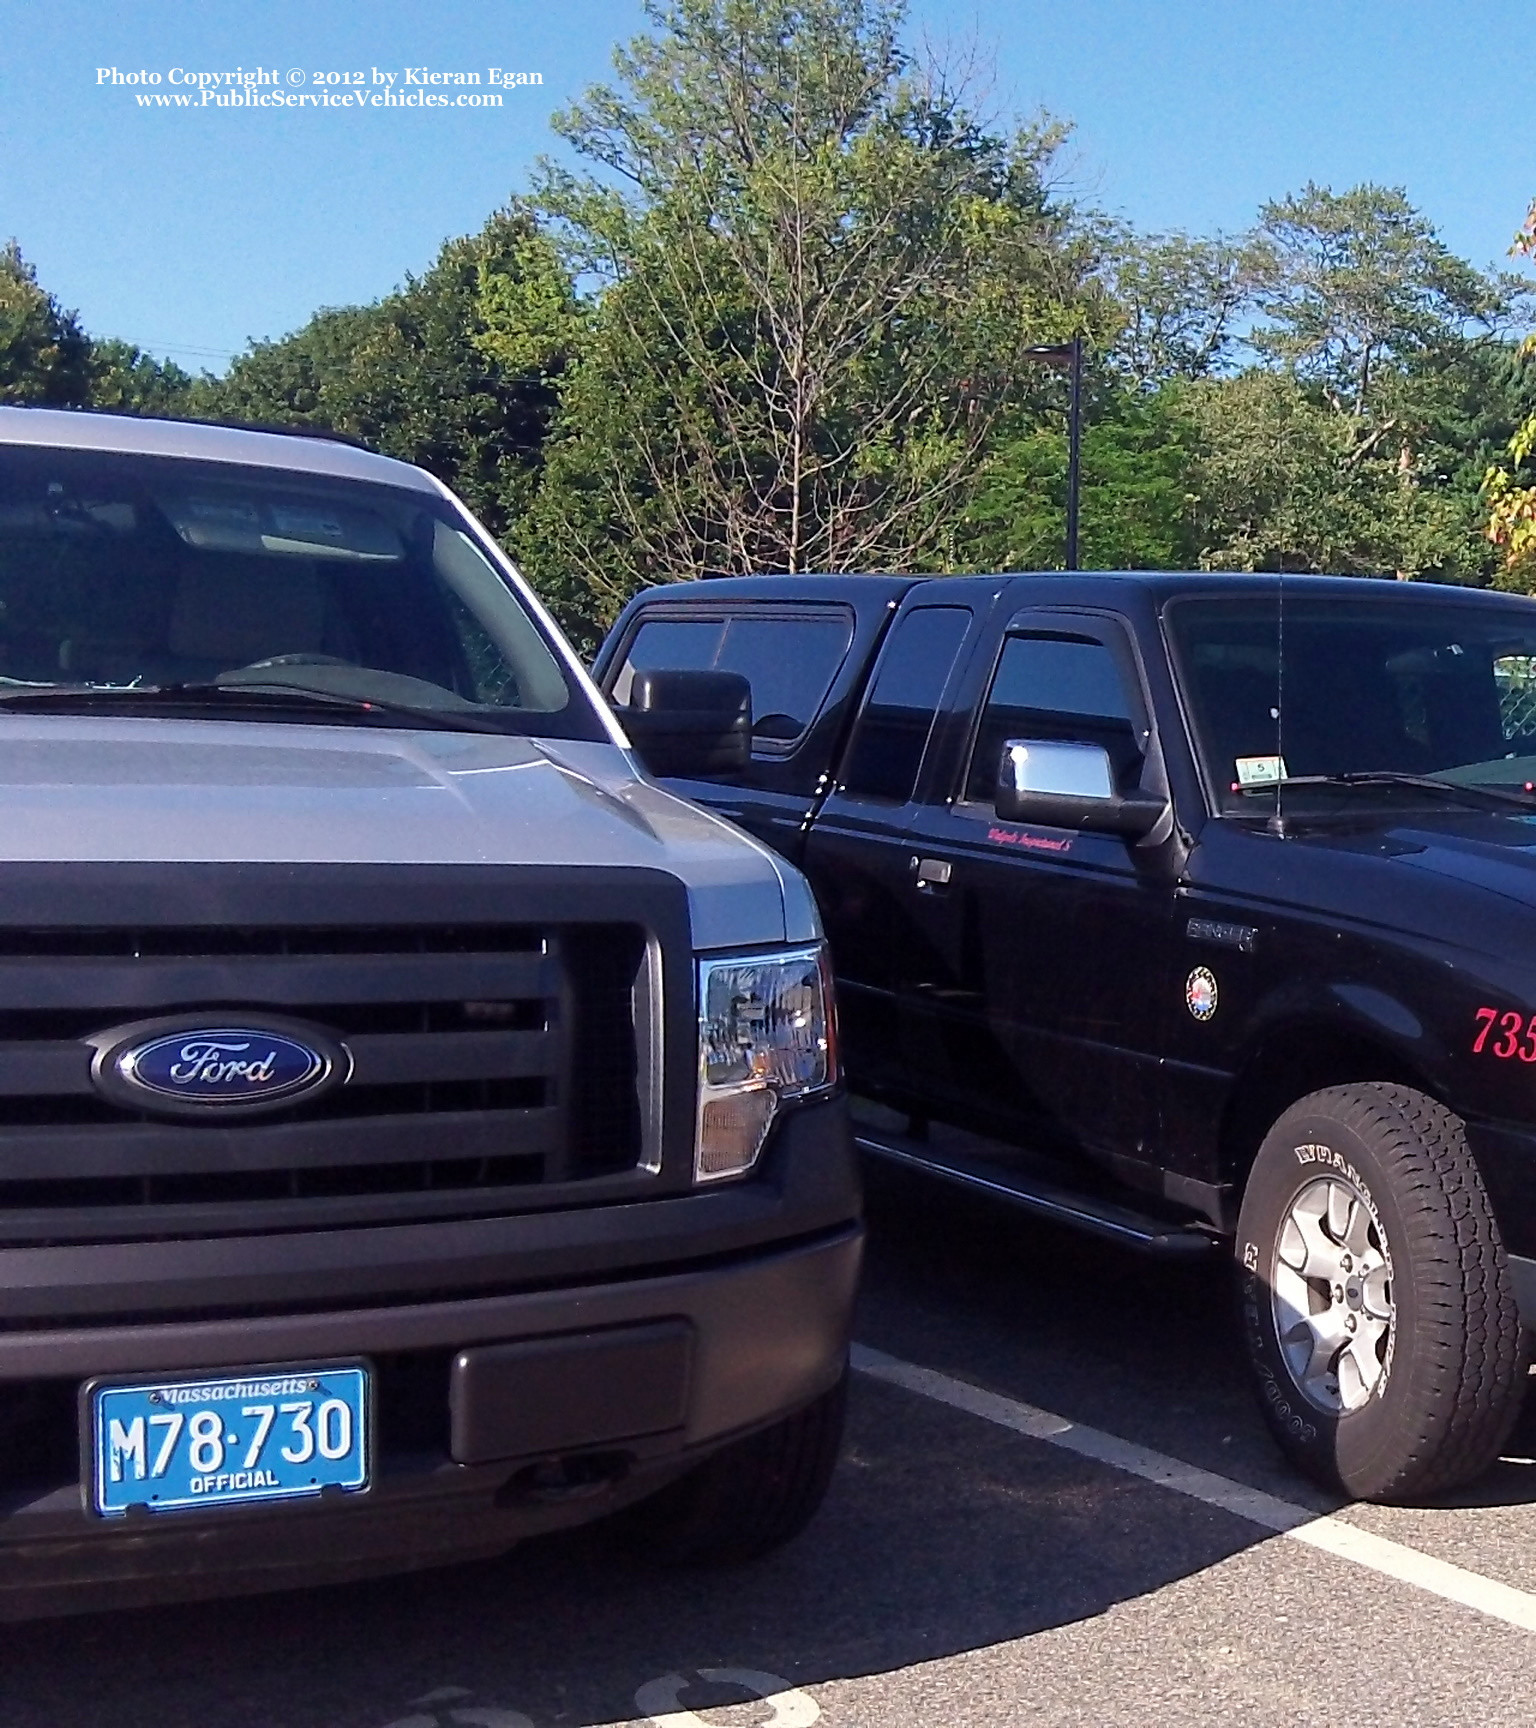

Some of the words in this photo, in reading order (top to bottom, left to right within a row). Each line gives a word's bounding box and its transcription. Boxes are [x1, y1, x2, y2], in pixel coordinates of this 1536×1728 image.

[169, 1041, 278, 1084] Ford
[160, 1377, 308, 1405] Massachusetts
[190, 1469, 280, 1495] OFFICIAL
